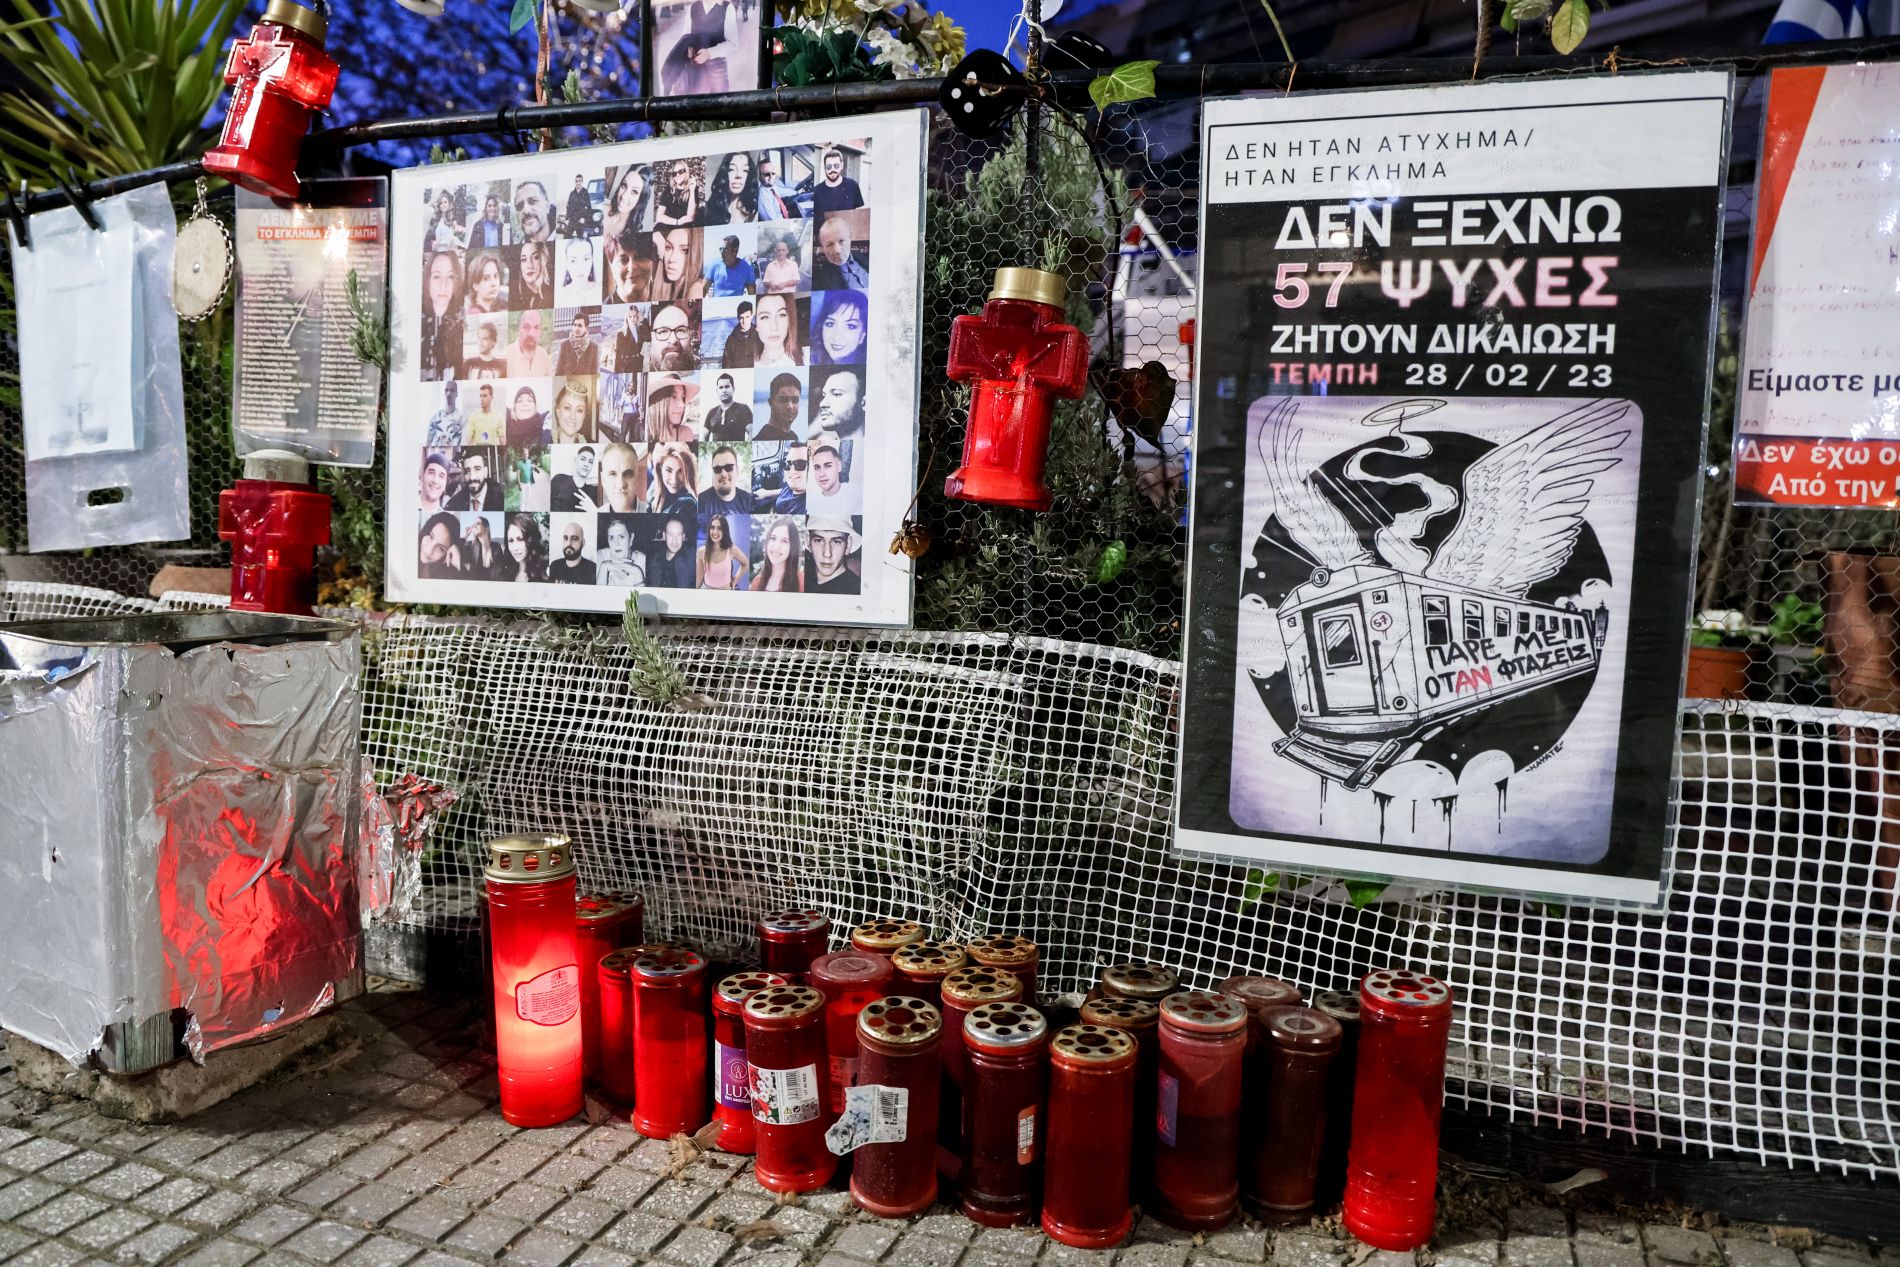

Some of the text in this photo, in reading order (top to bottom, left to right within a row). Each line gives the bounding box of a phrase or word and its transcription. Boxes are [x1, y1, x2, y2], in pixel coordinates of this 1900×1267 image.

[1226, 129, 1534, 160] ΔΕΝ ΗΤΑΝ ΑΤΥΧΗΜΑ/
[1226, 161, 1447, 187] ΗΤΑΝ ΕΓΚΛΗΜΑ
[260, 229, 273, 239] ΤΟ
[274, 228, 321, 239] ΕΓΚΛΗΜΑ
[1274, 195, 1621, 250] ΔΕΝ ΞΕΧΝΩ
[1273, 257, 1618, 308] 57 ΨΥΧΕΣ
[1270, 323, 1615, 354] ΖΗΤΟΥΝ ΔΙΚΑΙΩΣΗ
[1269, 363, 1378, 385] ΤΕΜΠΗ
[1406, 364, 1446, 386] 28
[1485, 364, 1528, 386] 02
[1569, 364, 1612, 387] 23
[1748, 368, 1863, 397] Είμαστε
[1740, 440, 1796, 463] Δεν
[1810, 438, 1870, 470] έχω
[1768, 472, 1826, 496] Από
[1835, 479, 1886, 503] την
[1426, 630, 1567, 670] ΠΑΡΕ ΜΕ
[1425, 665, 1493, 698] ΟΤΑΝ
[725, 1083, 751, 1099] LUX
